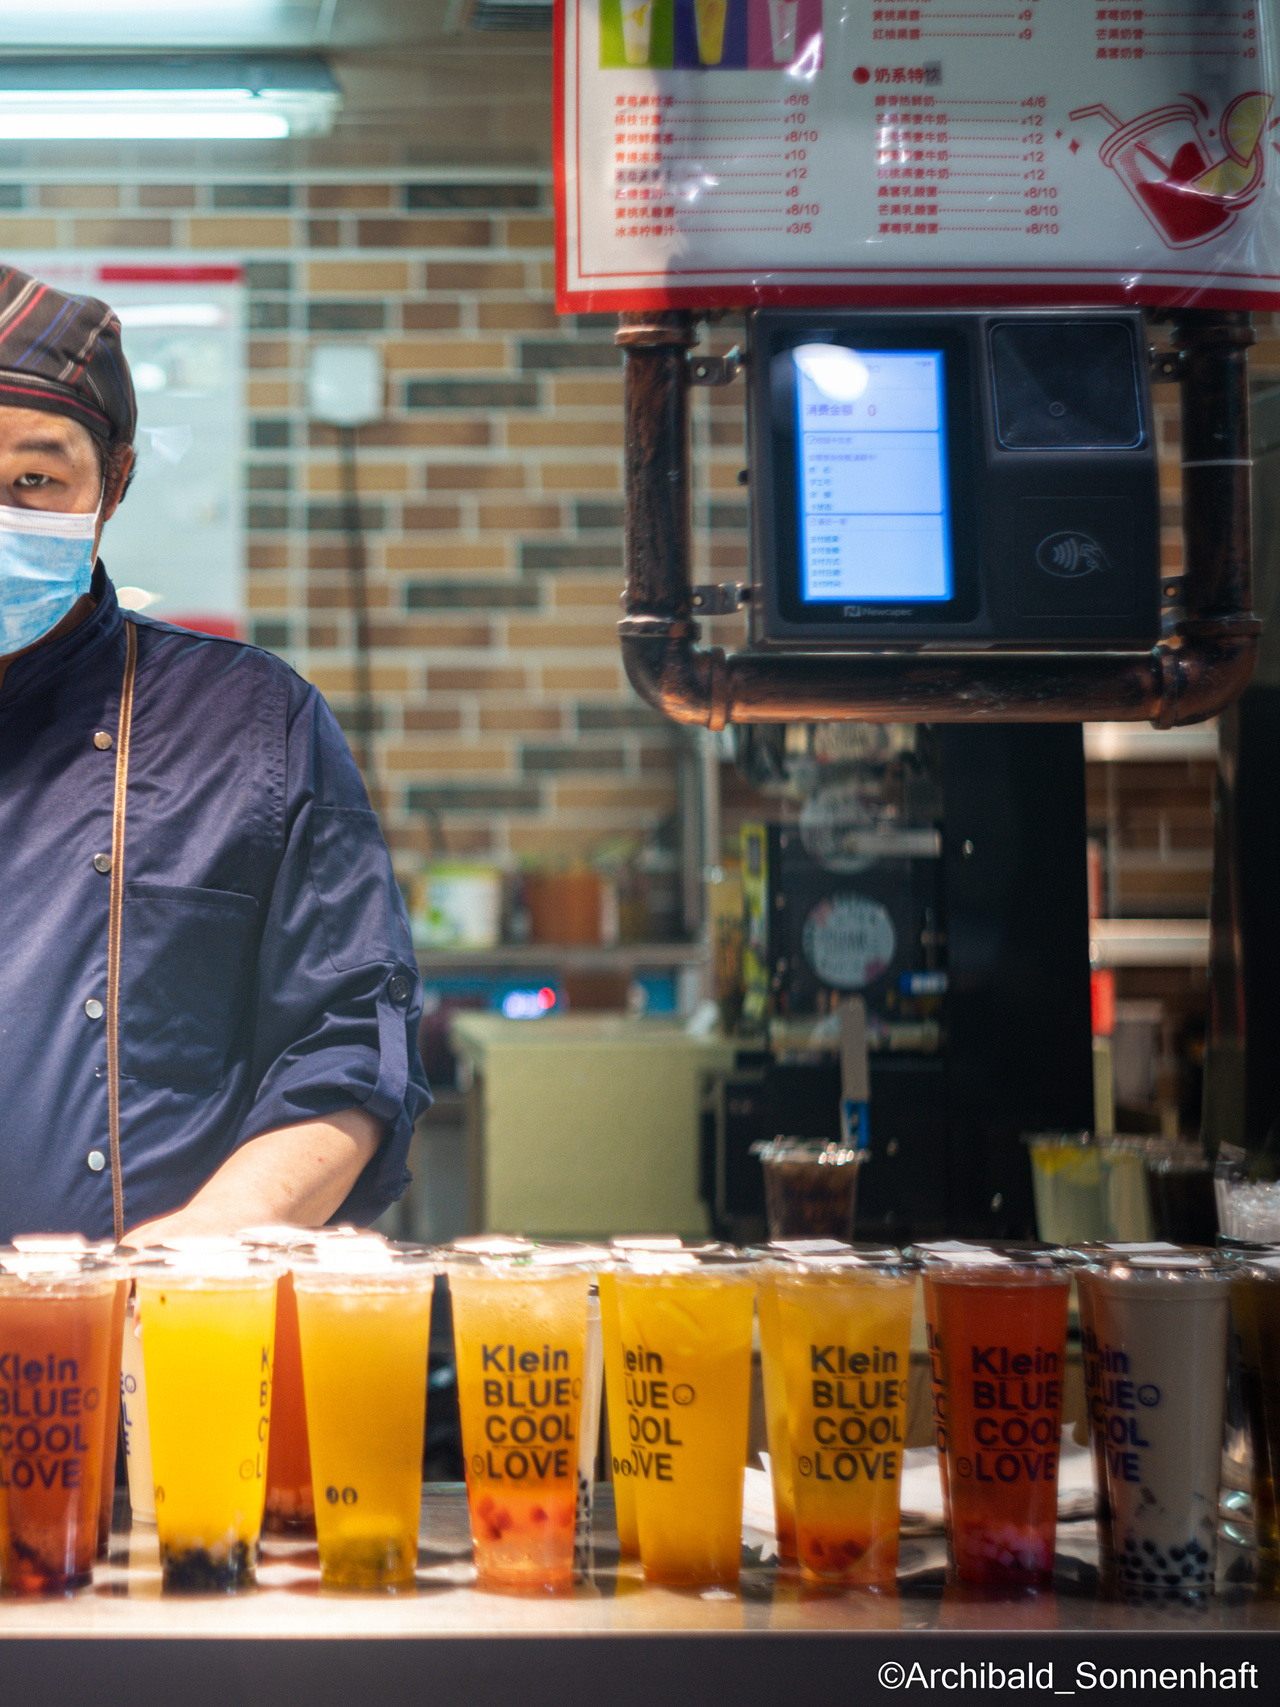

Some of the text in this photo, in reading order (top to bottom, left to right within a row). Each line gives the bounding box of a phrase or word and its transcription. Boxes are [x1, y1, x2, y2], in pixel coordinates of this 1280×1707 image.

[1096, 28, 1144, 40] 芒果奶昔
[806, 404, 876, 417] 消费金额 0
[481, 1344, 568, 1373] Klein
[811, 1345, 897, 1374] Klein
[972, 1346, 1058, 1375] Klein
[484, 1378, 571, 1408] BLUE
[812, 1380, 899, 1410] BLUE
[973, 1380, 1059, 1411] BLUE
[485, 1413, 575, 1444] COOL
[813, 1415, 902, 1446] COOL
[974, 1416, 1060, 1447] COOL
[0, 1458, 80, 1489] LOVE
[487, 1449, 568, 1480] LOVE
[815, 1451, 896, 1482] LOVE
[976, 1452, 1057, 1483] LOVE
